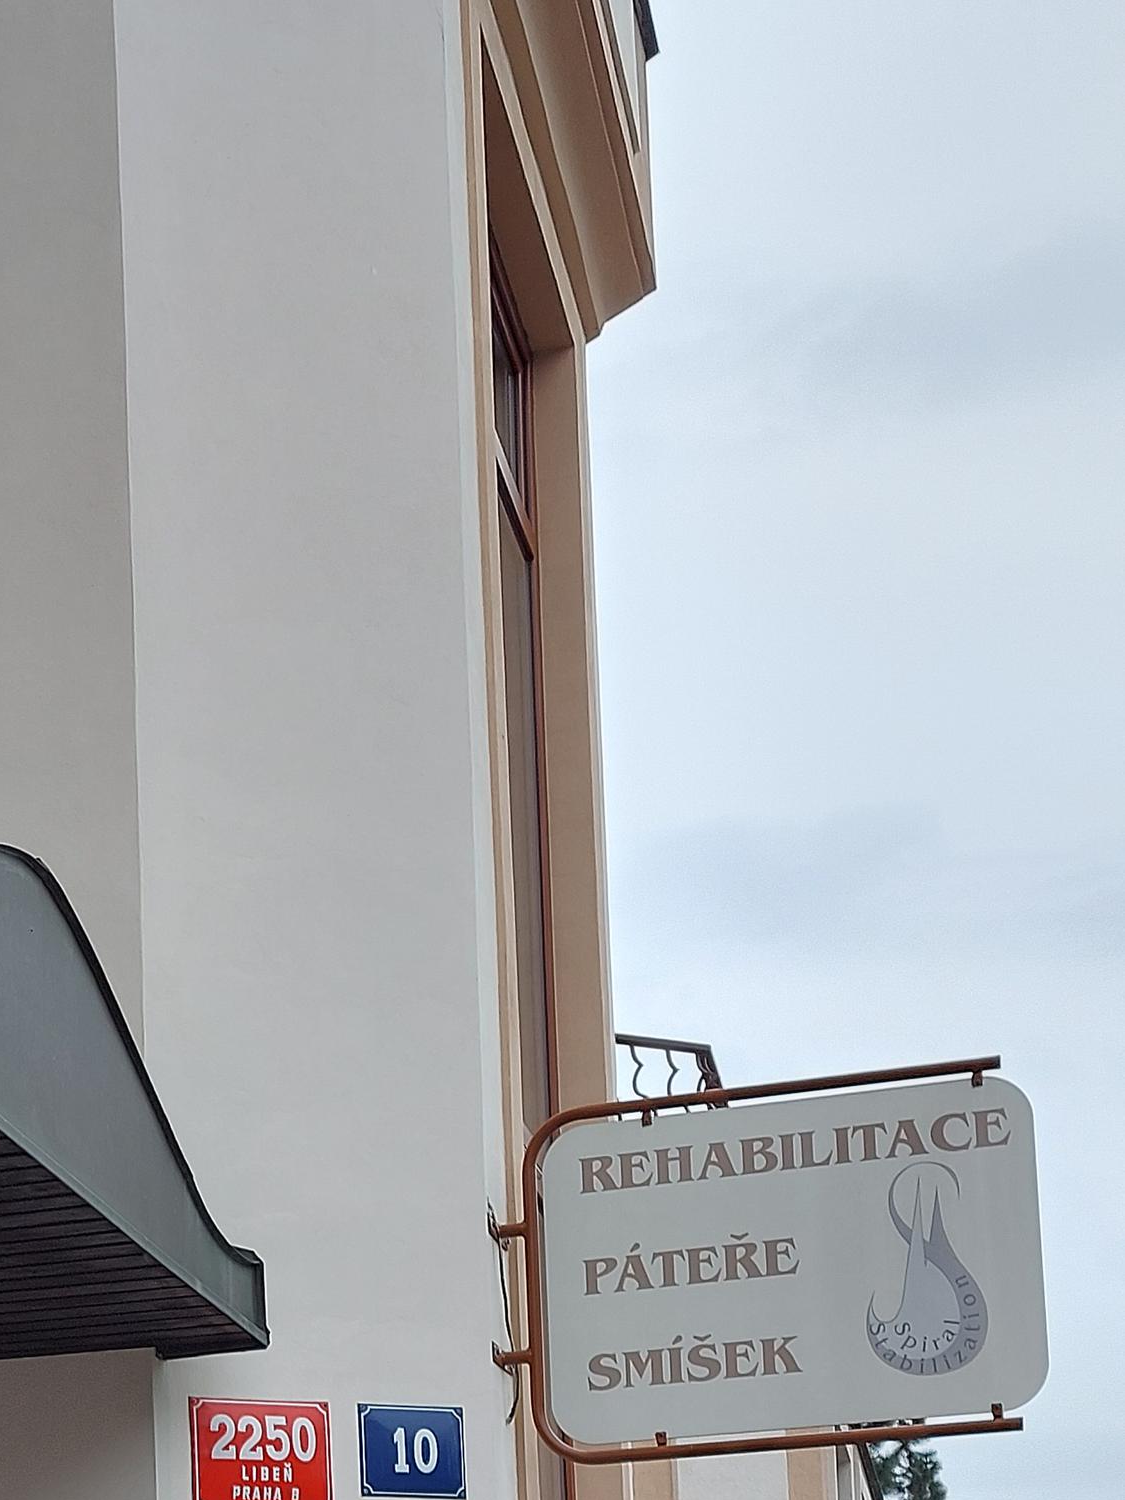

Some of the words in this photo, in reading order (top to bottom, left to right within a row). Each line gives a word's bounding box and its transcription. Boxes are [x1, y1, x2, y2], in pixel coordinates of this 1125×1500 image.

[578, 1107, 1012, 1194] REHABILITACE
[583, 1232, 799, 1296] PÁTEŘE
[869, 1275, 981, 1373] Stabilization
[894, 1320, 960, 1352] Spiral
[587, 1333, 803, 1392] SMÍŠEK
[209, 1413, 317, 1463] 2250
[393, 1426, 438, 1474] 10
[241, 1463, 293, 1483] LIBEŇ
